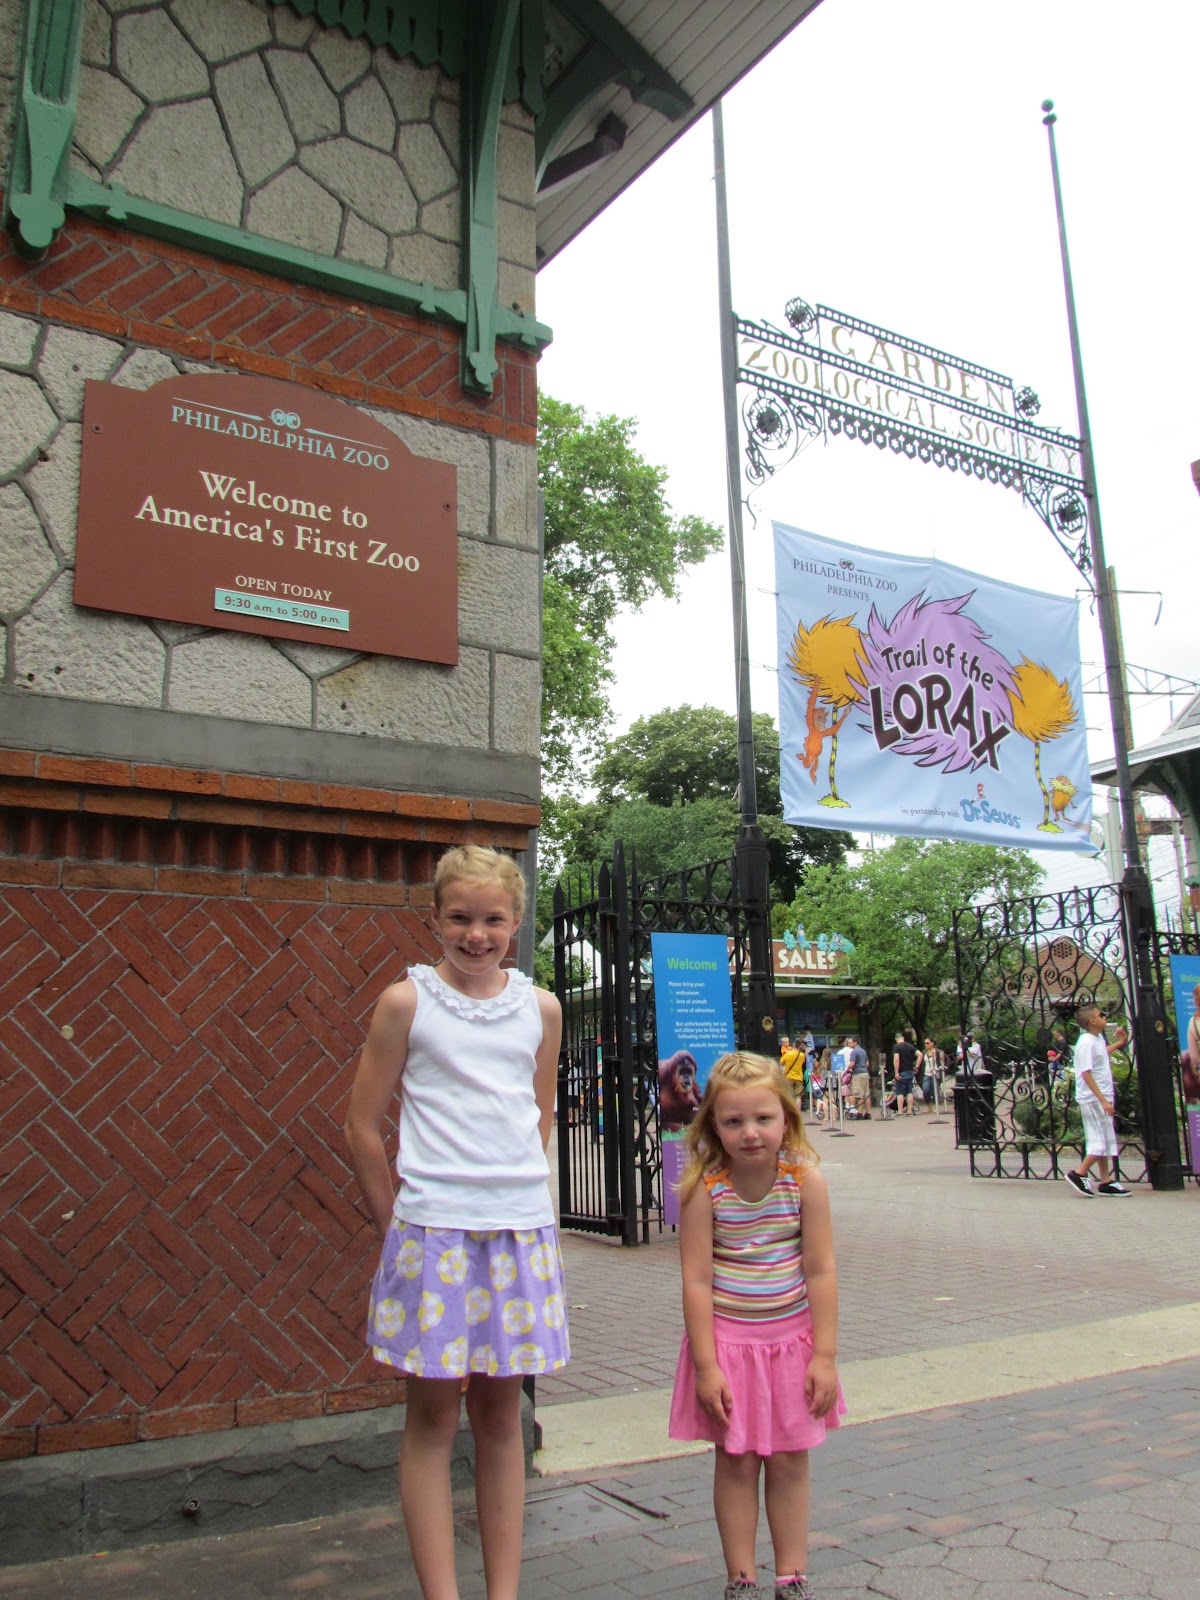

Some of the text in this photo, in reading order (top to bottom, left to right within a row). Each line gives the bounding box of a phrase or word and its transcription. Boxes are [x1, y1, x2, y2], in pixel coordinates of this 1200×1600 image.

[831, 325, 1007, 414] GARDEN
[740, 338, 1078, 475] ZOOLOGICAL SOCIETY
[171, 405, 389, 471] PHILADELPHIA ZOO
[199, 470, 369, 529] Welcome to
[135, 495, 420, 572] America's First Zoo
[235, 575, 332, 602] OPEN TODAY
[793, 558, 898, 592] PHILADELPHIA ZOO
[827, 584, 870, 602] PRESENTS
[224, 596, 340, 624] 9:30 a.m. to 5:00 p.m.
[880, 638, 994, 692] Trail of the
[869, 673, 1011, 772] LORAX
[910, 808, 946, 818] partnership
[947, 810, 960, 818] with
[666, 958, 718, 971] Welcome
[778, 948, 838, 970] SALES
